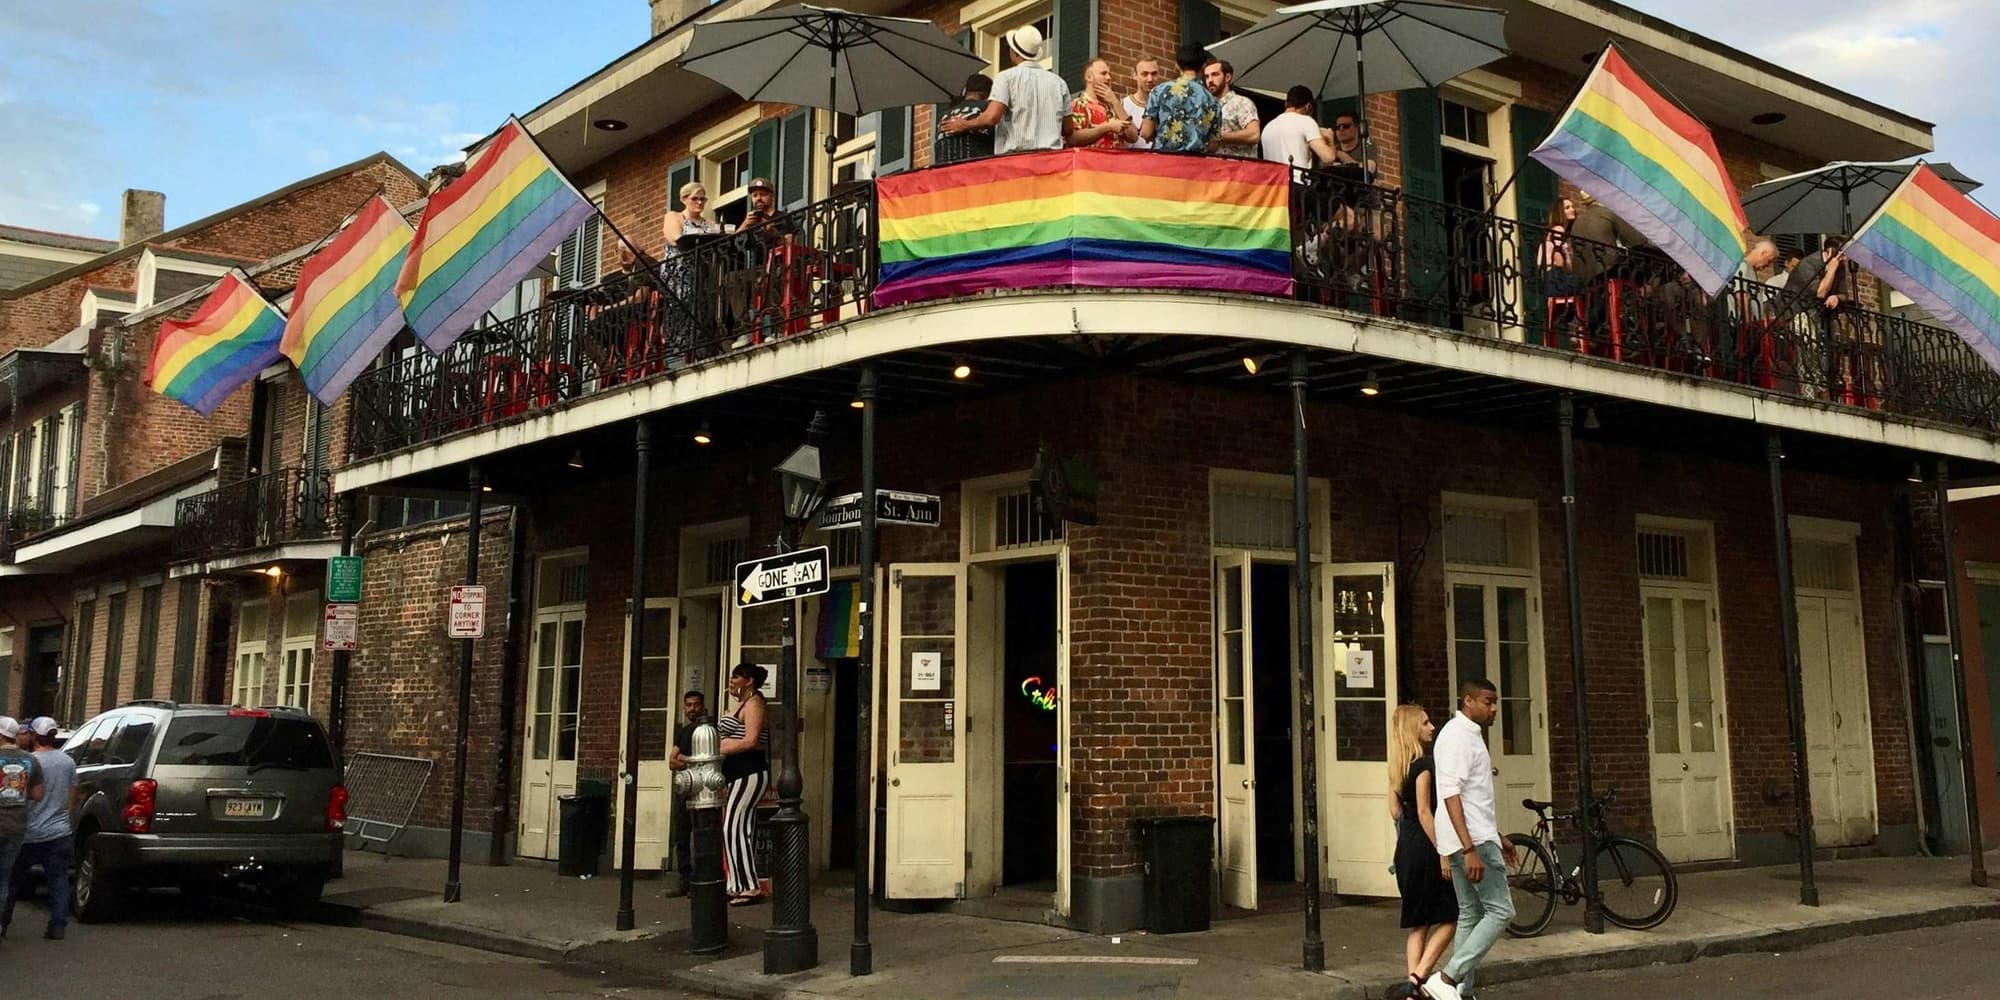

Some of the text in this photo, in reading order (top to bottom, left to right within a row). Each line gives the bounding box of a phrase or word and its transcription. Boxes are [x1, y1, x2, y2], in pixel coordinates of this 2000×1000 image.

[818, 506, 861, 524] Bourbon
[883, 500, 932, 521] St. Ann
[452, 591, 462, 600] NO
[455, 611, 480, 619] CORNER
